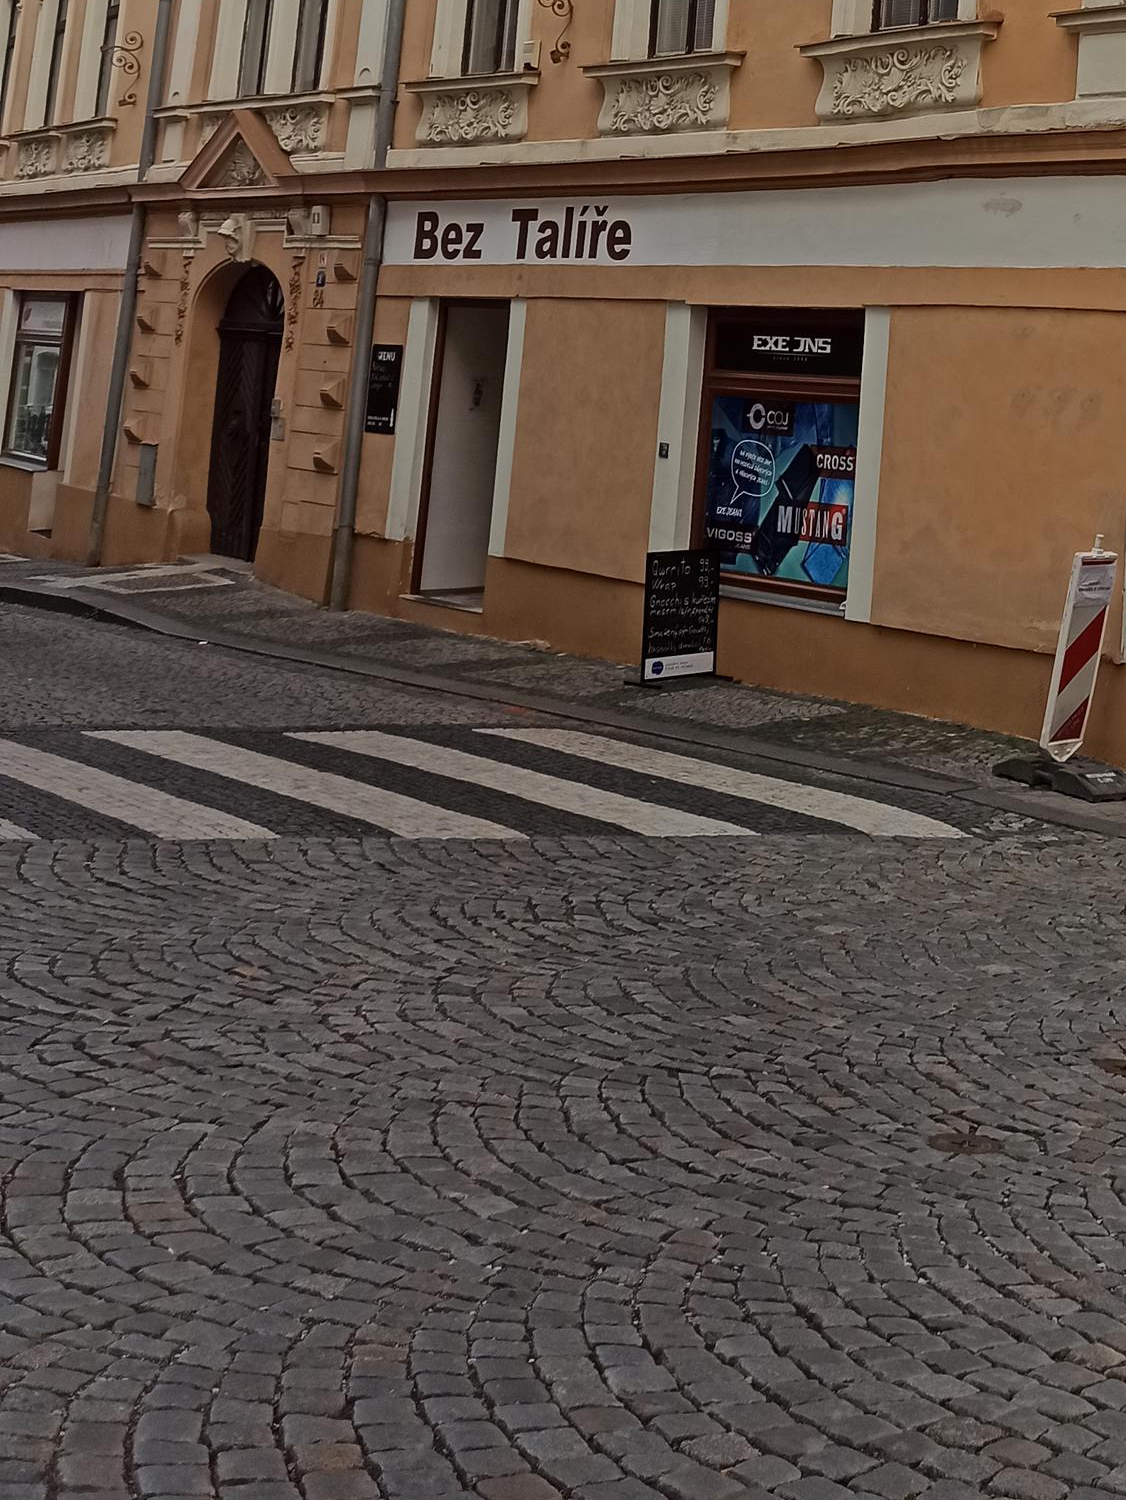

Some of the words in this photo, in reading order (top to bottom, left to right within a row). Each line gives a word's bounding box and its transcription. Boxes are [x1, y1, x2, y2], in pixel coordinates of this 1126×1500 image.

[413, 211, 485, 260] Bez
[511, 205, 633, 260] Talíře
[752, 335, 791, 352] EXE
[792, 336, 832, 354] JNS
[767, 410, 789, 426] COJ
[816, 453, 854, 471] CROSS
[777, 505, 844, 541] MUSTANG
[706, 527, 752, 544] VIGOSS
